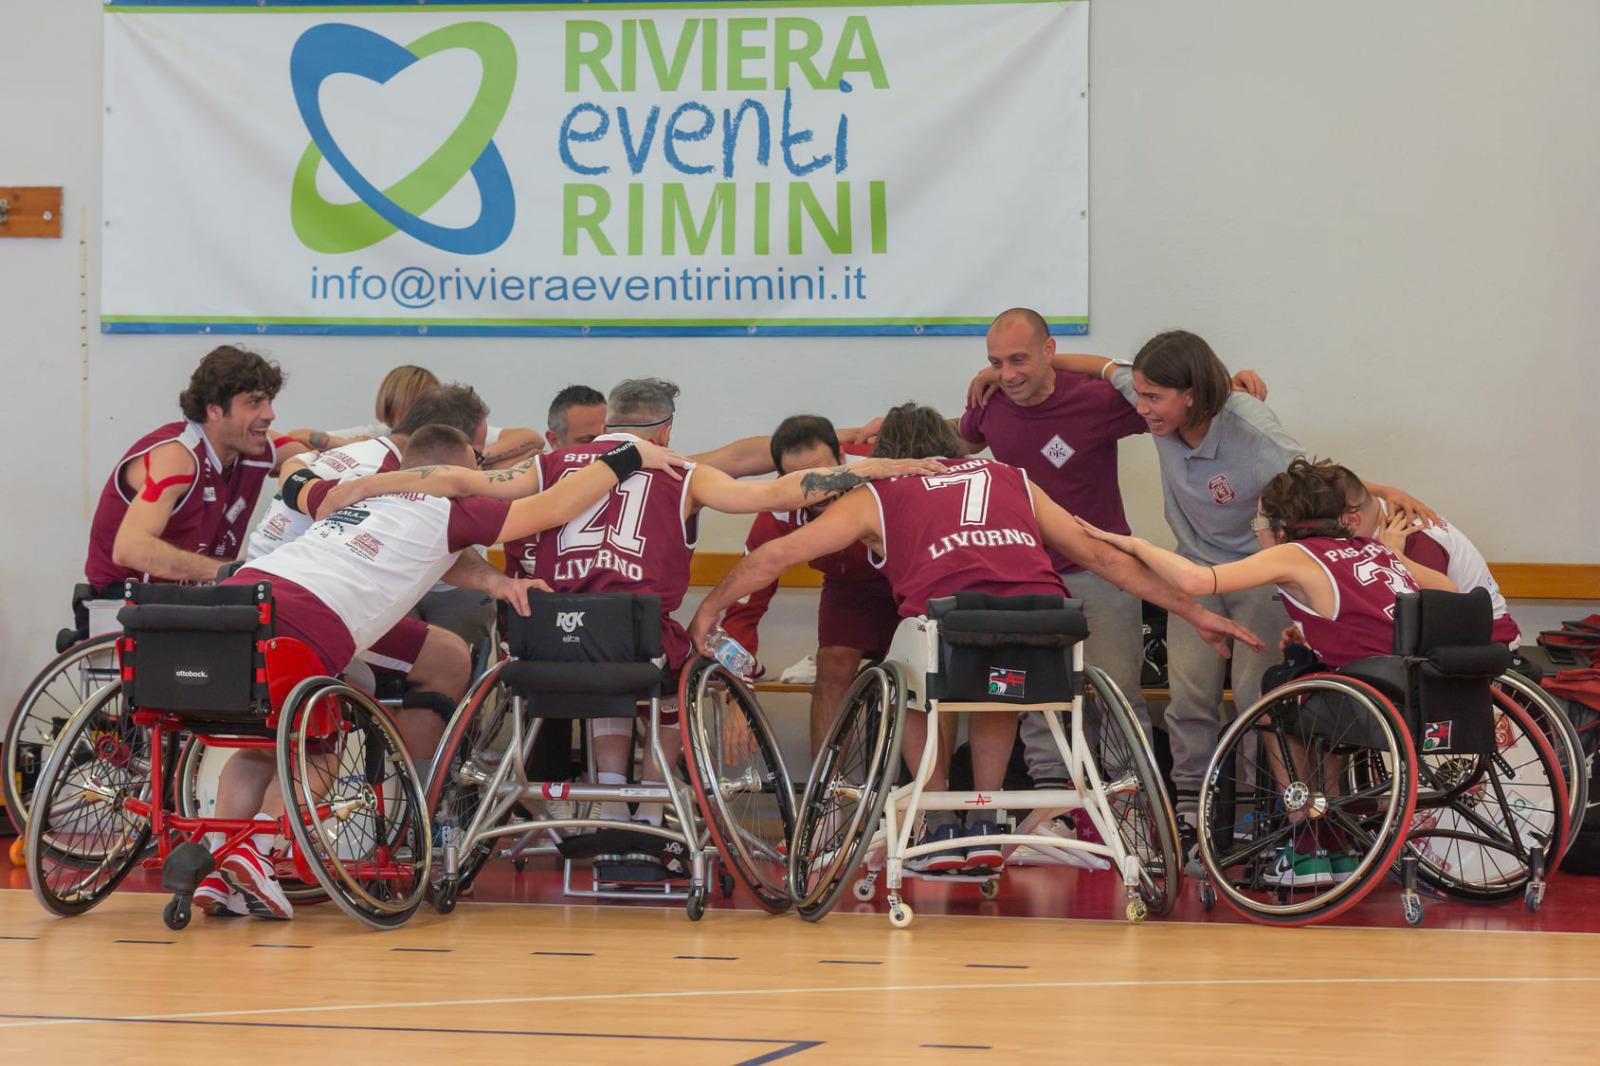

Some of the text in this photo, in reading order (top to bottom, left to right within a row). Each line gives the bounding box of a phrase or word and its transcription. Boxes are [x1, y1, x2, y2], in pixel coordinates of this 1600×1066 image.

[563, 16, 890, 92] RIVIERA
[558, 80, 853, 178] eventi
[562, 181, 888, 256] RIMINI
[311, 266, 868, 308] info@rivieraeventirimini.it
[557, 467, 653, 557] 21
[922, 467, 992, 527] 7
[554, 549, 643, 581] LIVRNO
[928, 528, 1037, 560] LIVORNO
